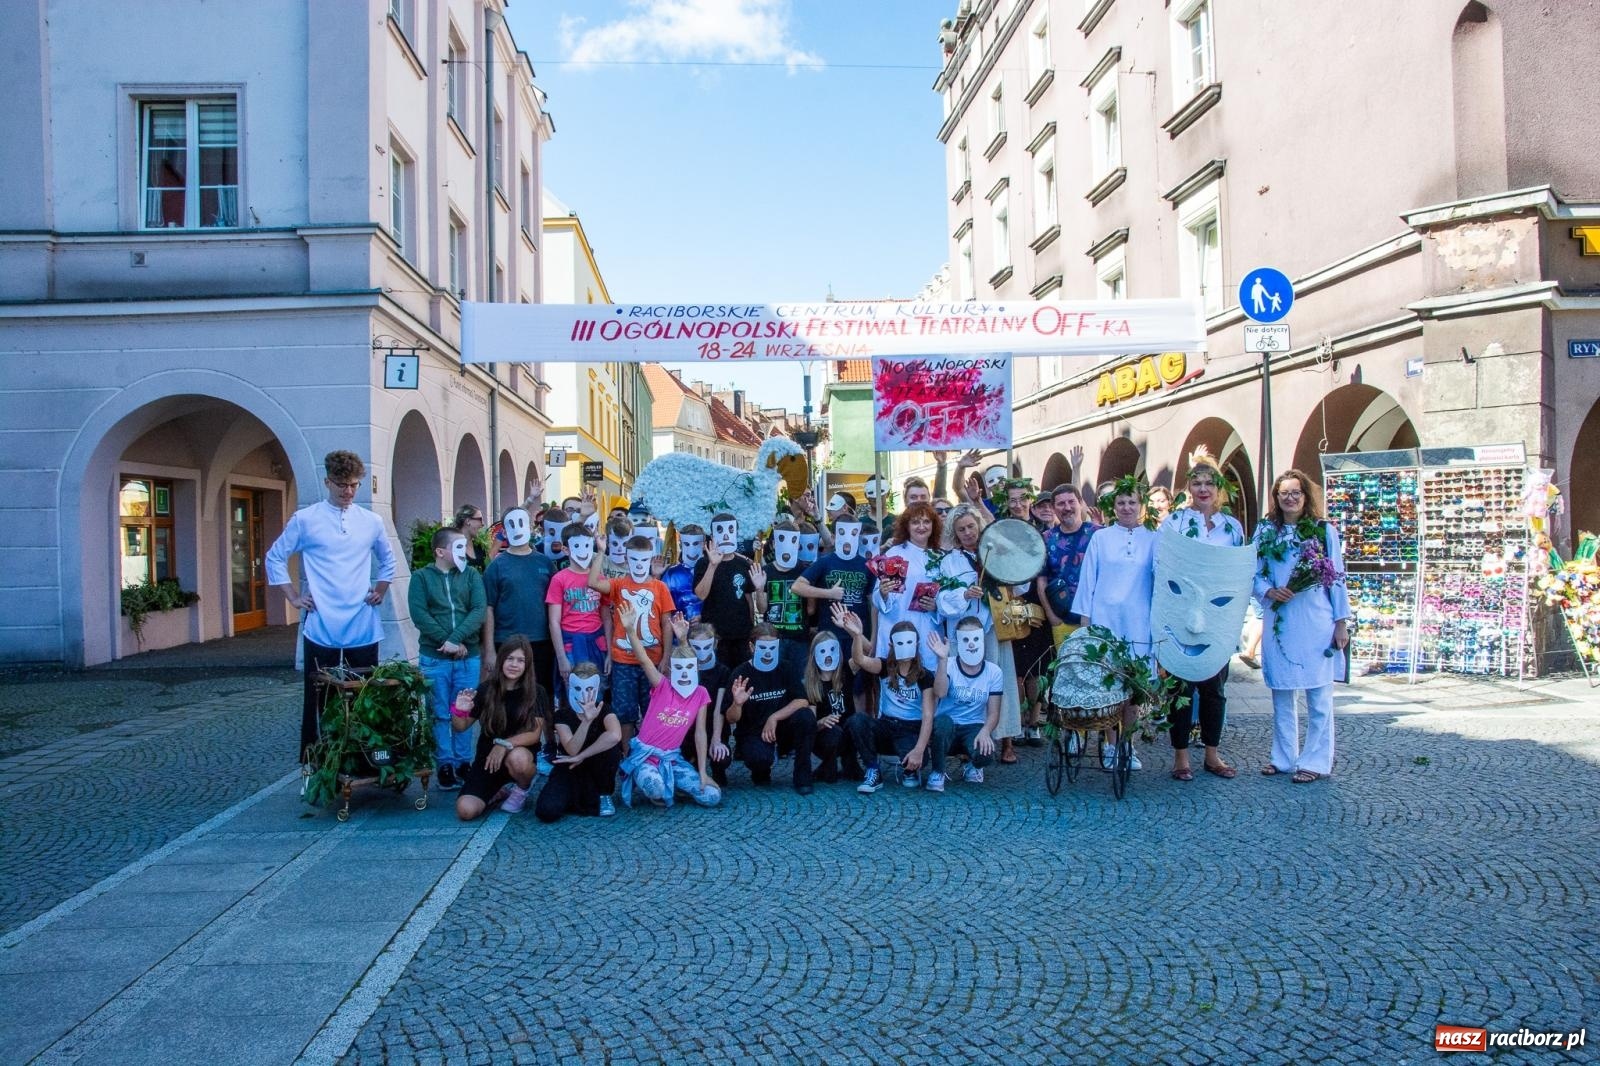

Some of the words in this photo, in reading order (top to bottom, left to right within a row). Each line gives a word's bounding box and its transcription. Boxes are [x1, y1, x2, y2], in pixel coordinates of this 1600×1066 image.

[628, 305, 764, 319] RACIBORSKIE
[776, 304, 879, 320] CENTRUM
[895, 303, 992, 318] KULTURY
[571, 319, 596, 341] III
[599, 319, 799, 340] OGÓLNOPOLSKI
[805, 317, 912, 337] FESTIWAL
[914, 315, 1027, 336] TEATRALNY
[1261, 326, 1288, 335] dotyczy
[697, 341, 756, 360] 18-24
[906, 371, 974, 385] FESTIWAL
[825, 570, 867, 583] STAR
[374, 750, 390, 761] JBL
